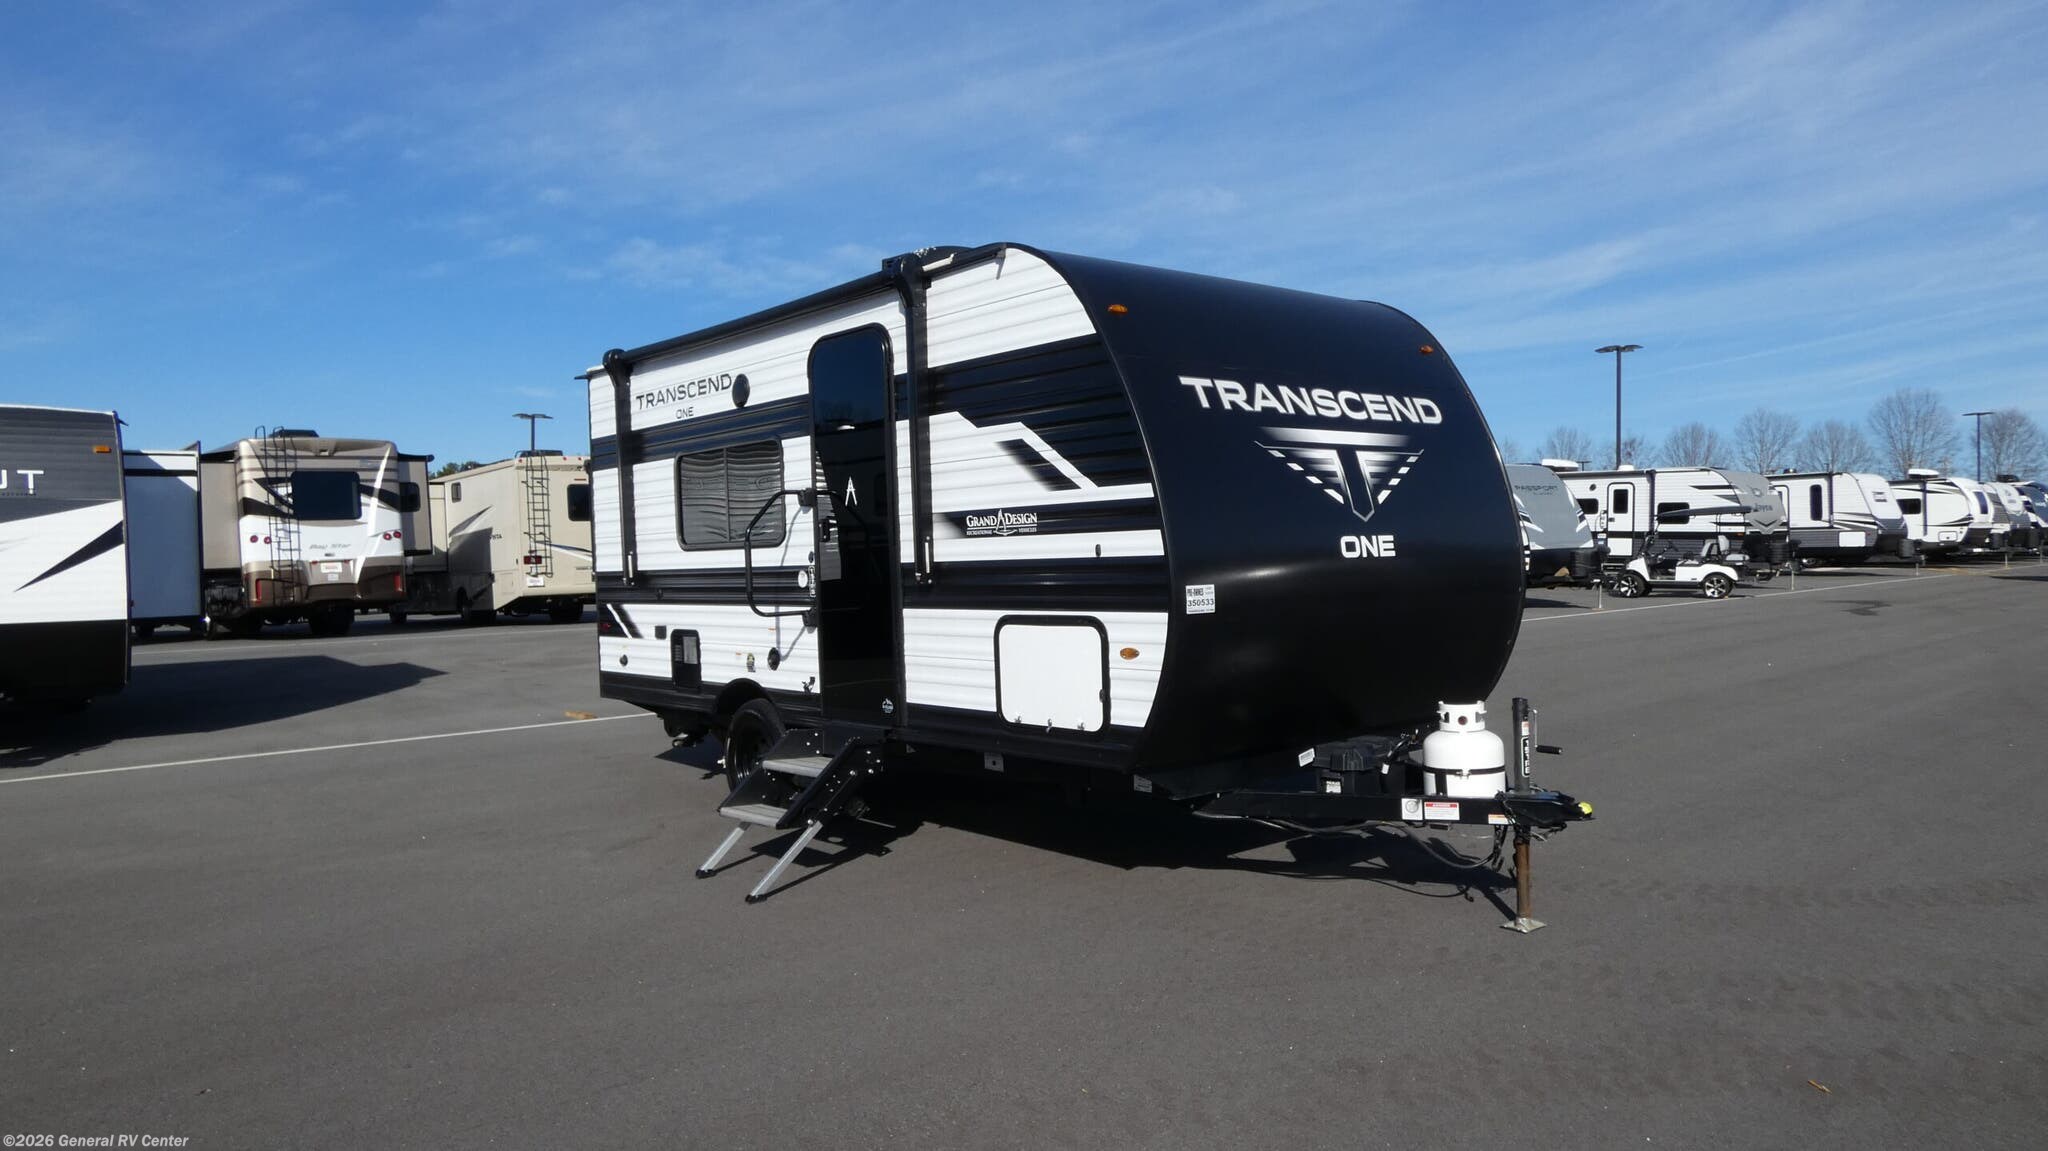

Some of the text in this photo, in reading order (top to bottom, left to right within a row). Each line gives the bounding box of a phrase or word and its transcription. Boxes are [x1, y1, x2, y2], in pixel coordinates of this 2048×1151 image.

[636, 373, 732, 410] TRANSCEND
[1178, 375, 1443, 425] TRANSCEND
[675, 406, 694, 420] ONE
[966, 512, 1038, 528] GRAND DESIGN
[1340, 534, 1396, 559] ONE
[1187, 598, 1215, 607] 350533
